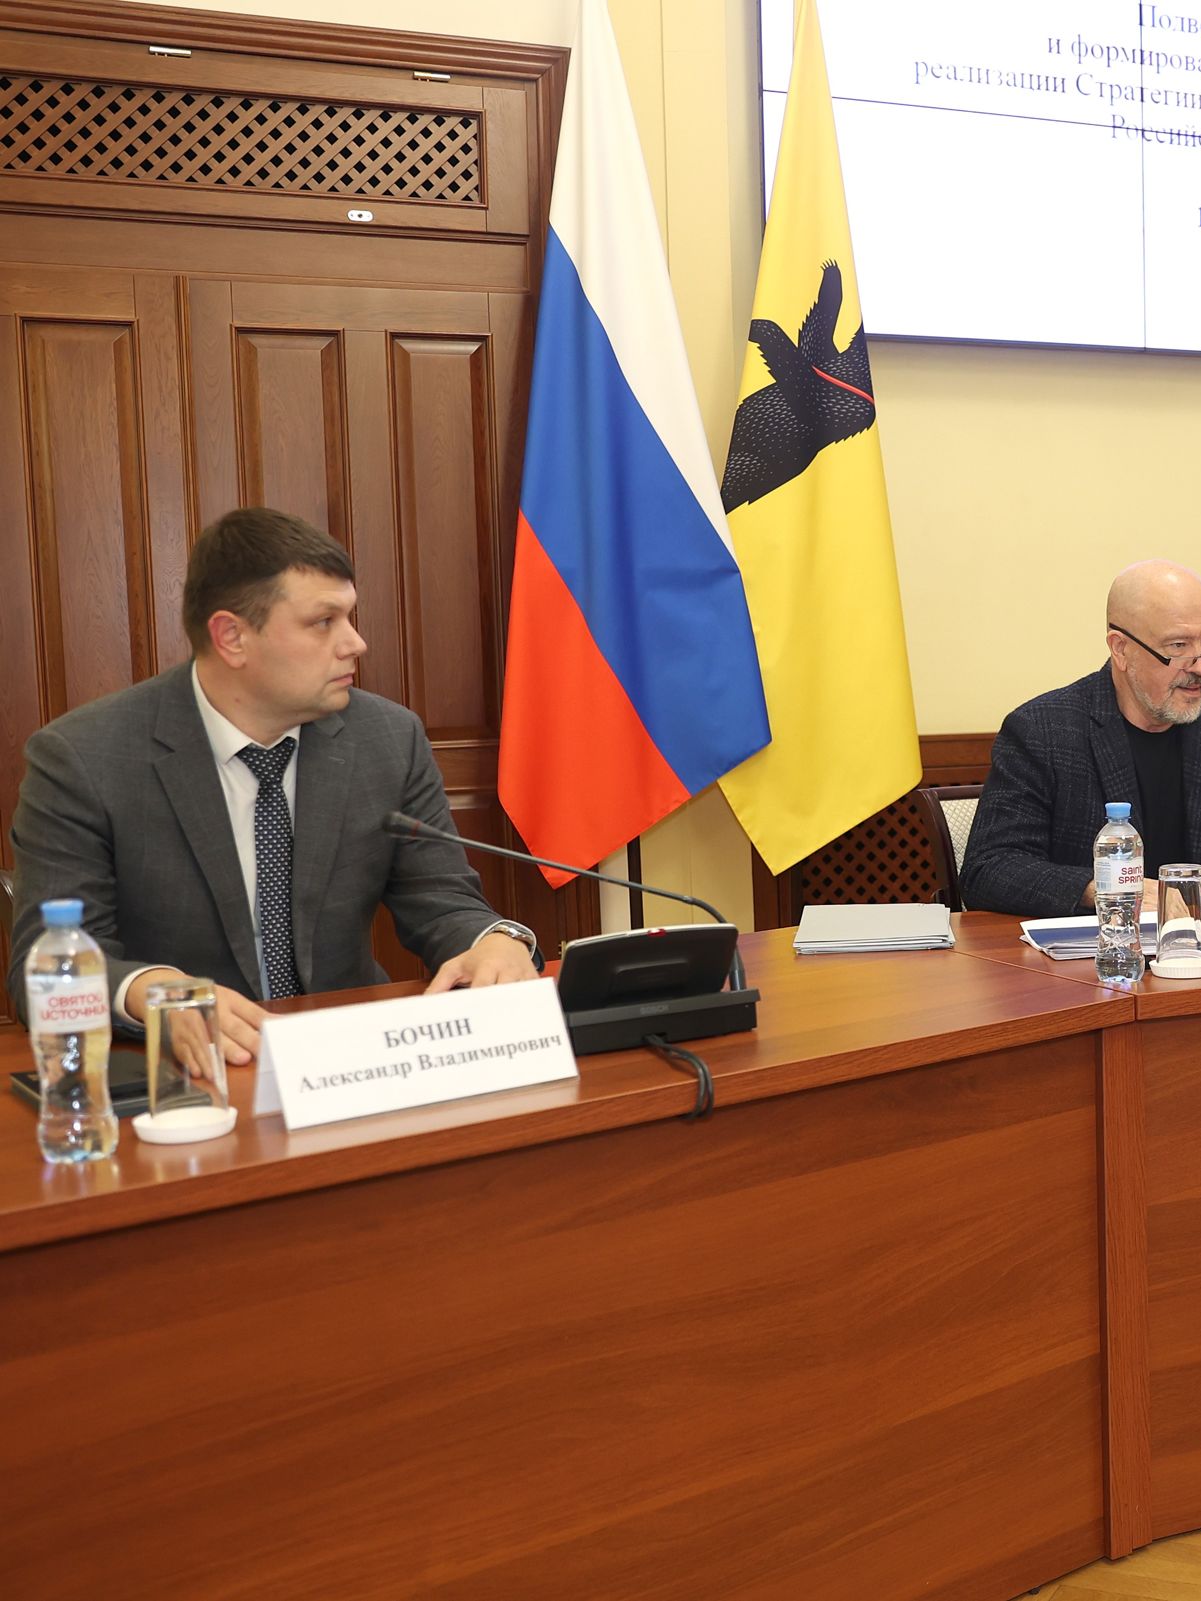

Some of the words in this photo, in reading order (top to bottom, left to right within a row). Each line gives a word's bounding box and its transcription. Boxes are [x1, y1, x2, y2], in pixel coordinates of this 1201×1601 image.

[1047, 36, 1062, 54] и
[914, 59, 1066, 94] реализации
[384, 1018, 472, 1048] БОЧИН
[299, 1061, 413, 1093] Александр
[417, 1034, 562, 1071] Владимирович
